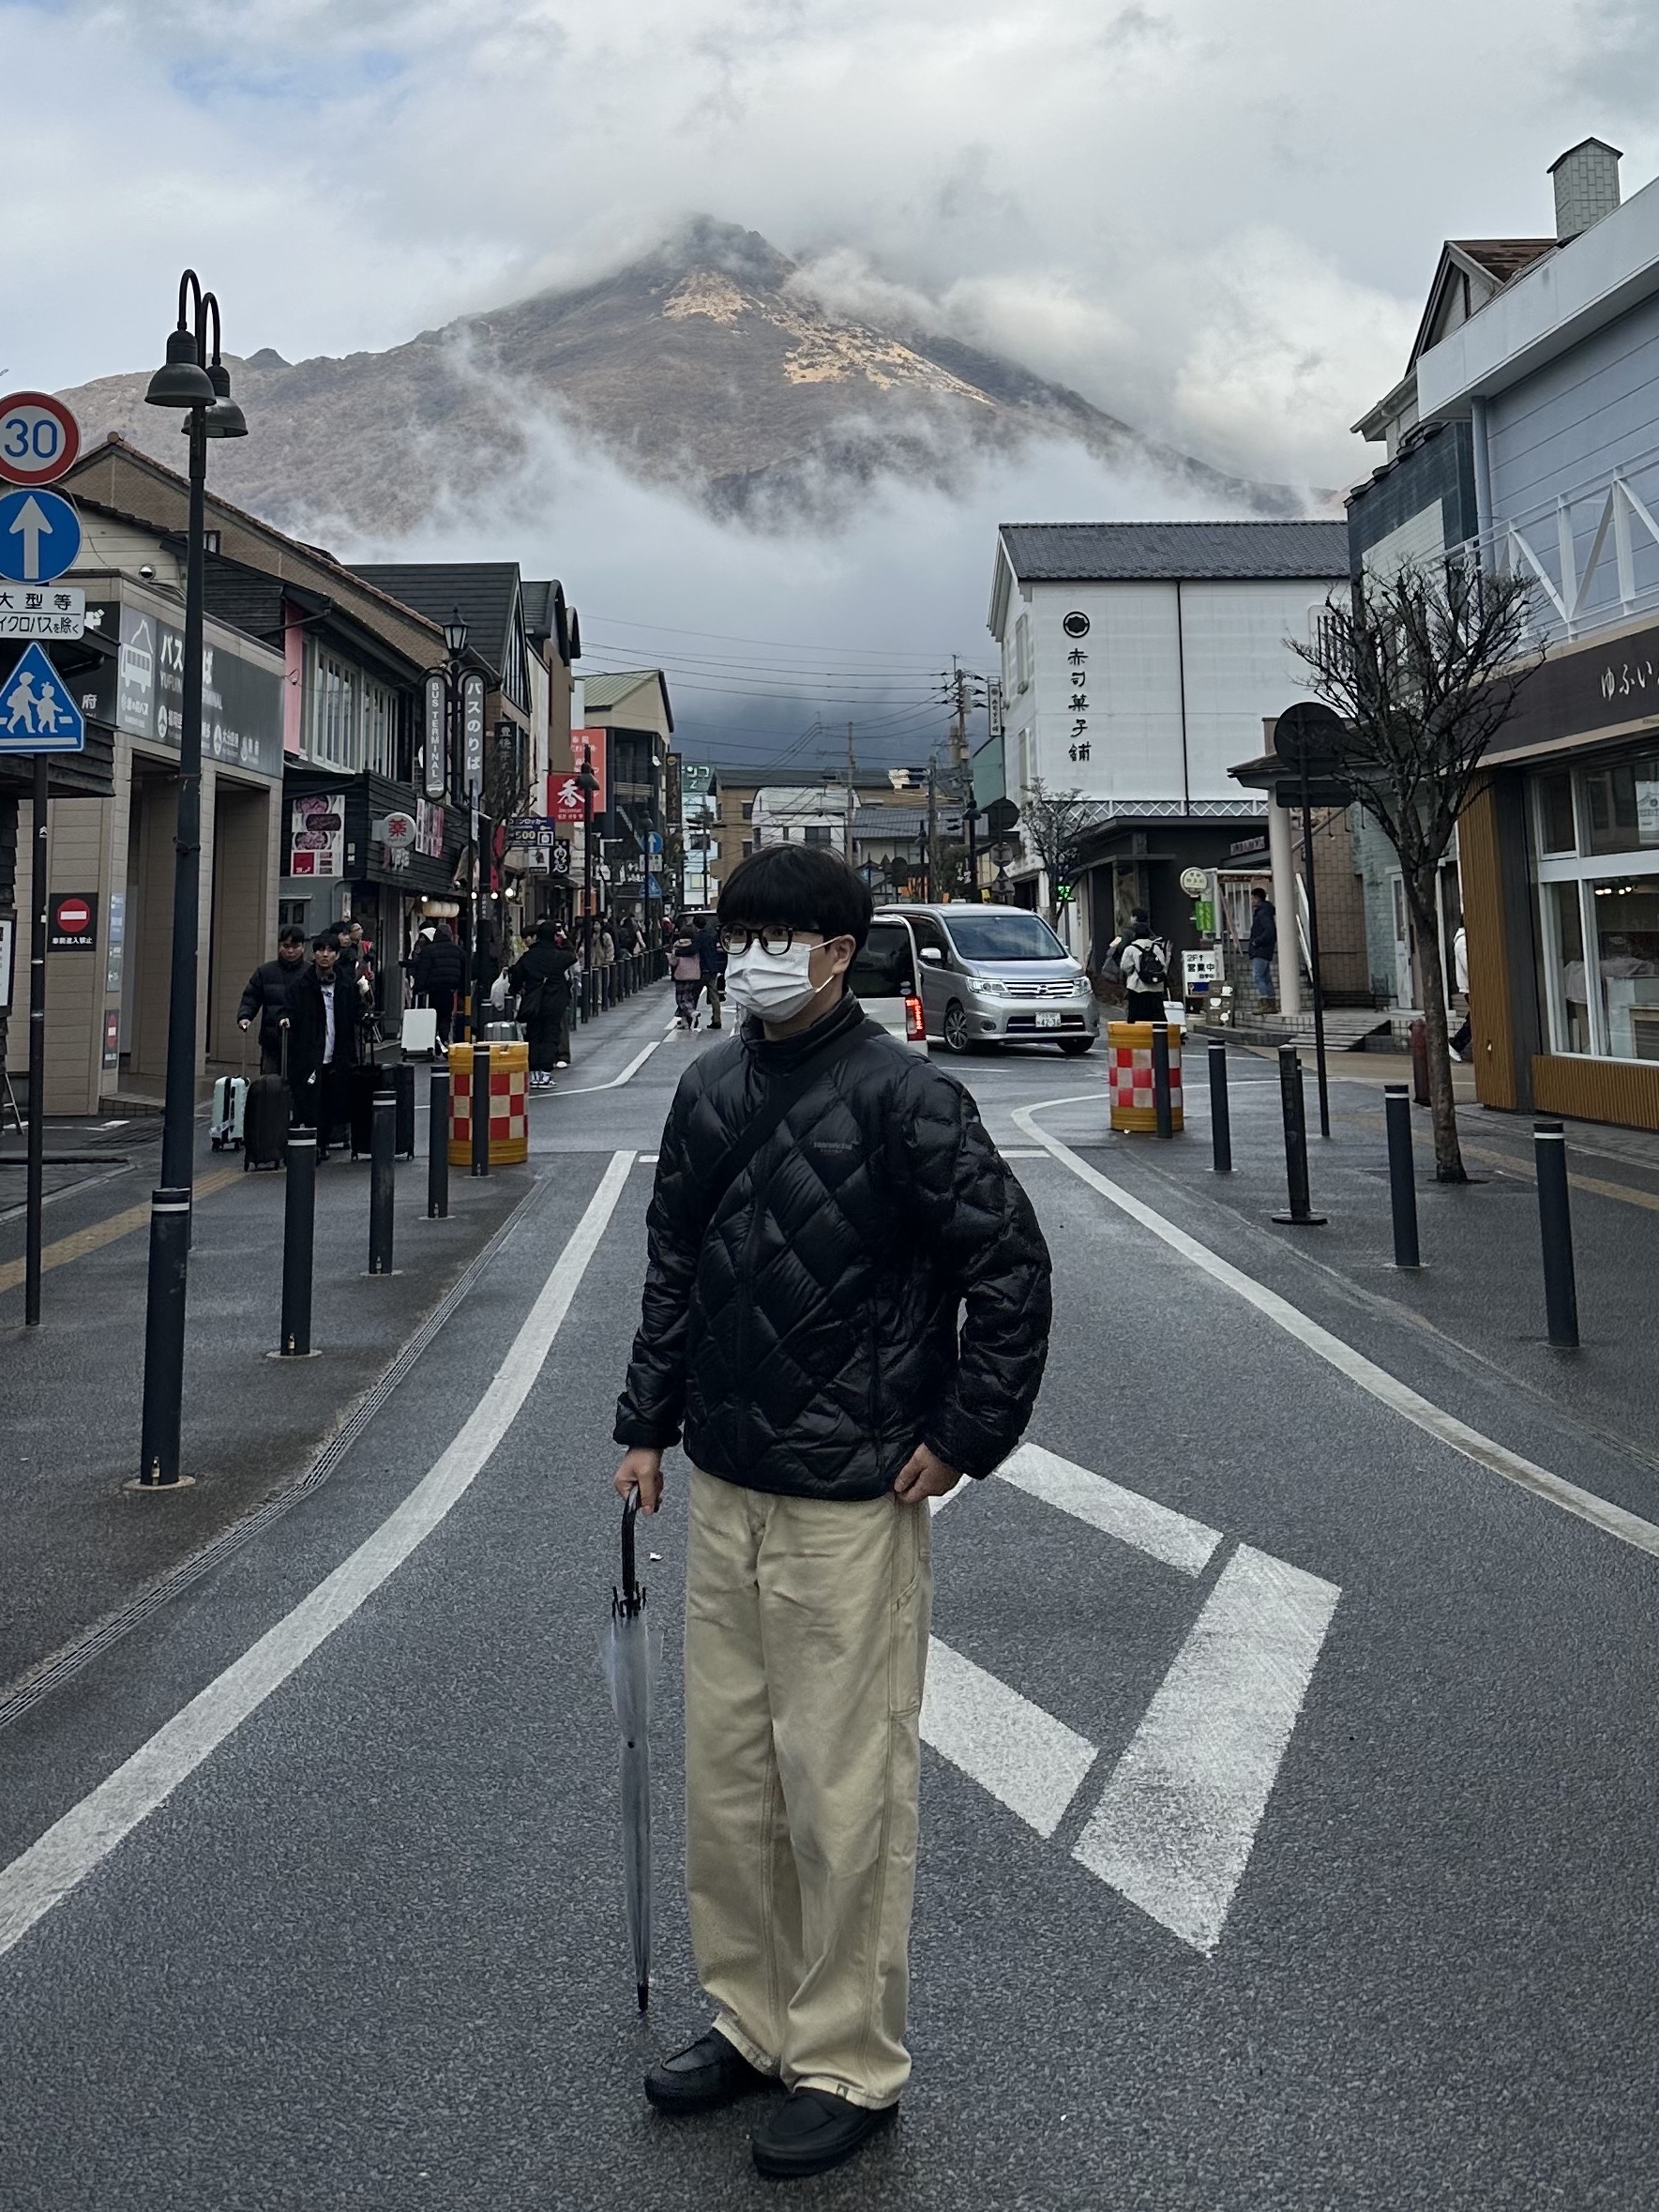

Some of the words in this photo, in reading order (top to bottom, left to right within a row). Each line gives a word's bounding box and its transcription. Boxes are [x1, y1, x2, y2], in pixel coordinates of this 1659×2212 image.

[5, 418, 57, 459] 30
[0, 592, 72, 611] 大型等
[431, 682, 440, 707] BUS
[1601, 660, 1659, 702] ゆふい
[467, 682, 482, 770] バスのりば
[430, 711, 440, 778] TERMINAL
[515, 830, 536, 840] 500
[1186, 962, 1214, 973] 営業中
